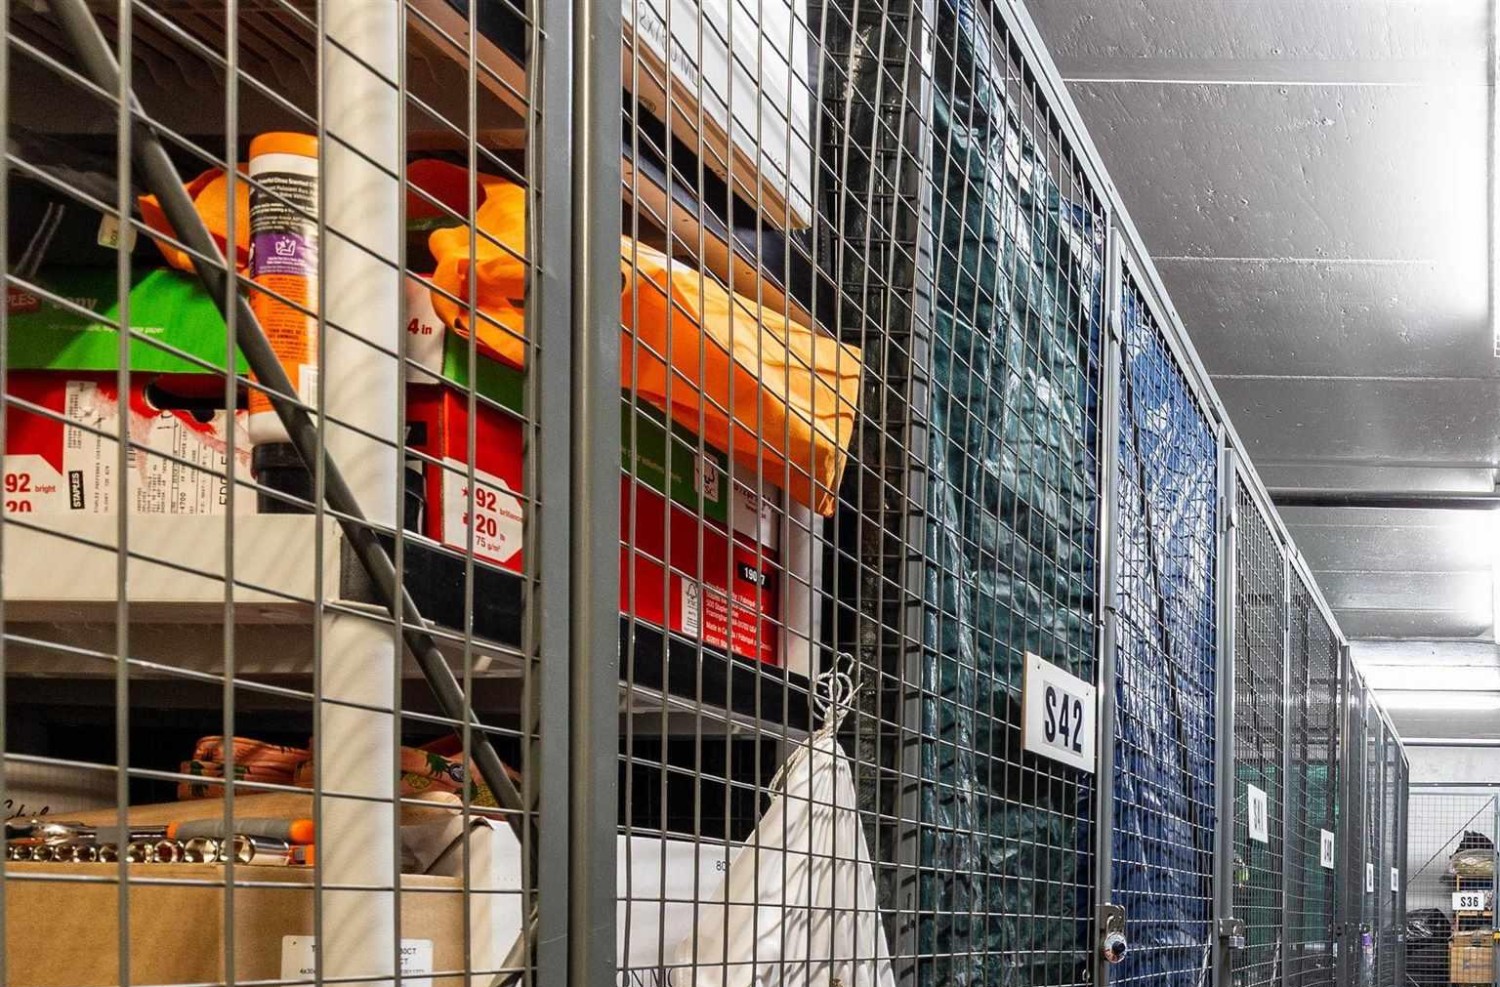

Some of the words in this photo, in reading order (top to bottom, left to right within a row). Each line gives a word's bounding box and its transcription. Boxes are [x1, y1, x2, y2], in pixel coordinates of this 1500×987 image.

[407, 318, 419, 335] 4
[421, 324, 432, 335] in
[5, 473, 31, 493] 92
[35, 484, 56, 493] bright
[72, 473, 84, 508] STAPLES
[475, 487, 497, 513] 92
[475, 514, 497, 537] 20
[476, 536, 486, 548] 75
[1044, 685, 1083, 754] S42
[1460, 896, 1479, 908] S36
